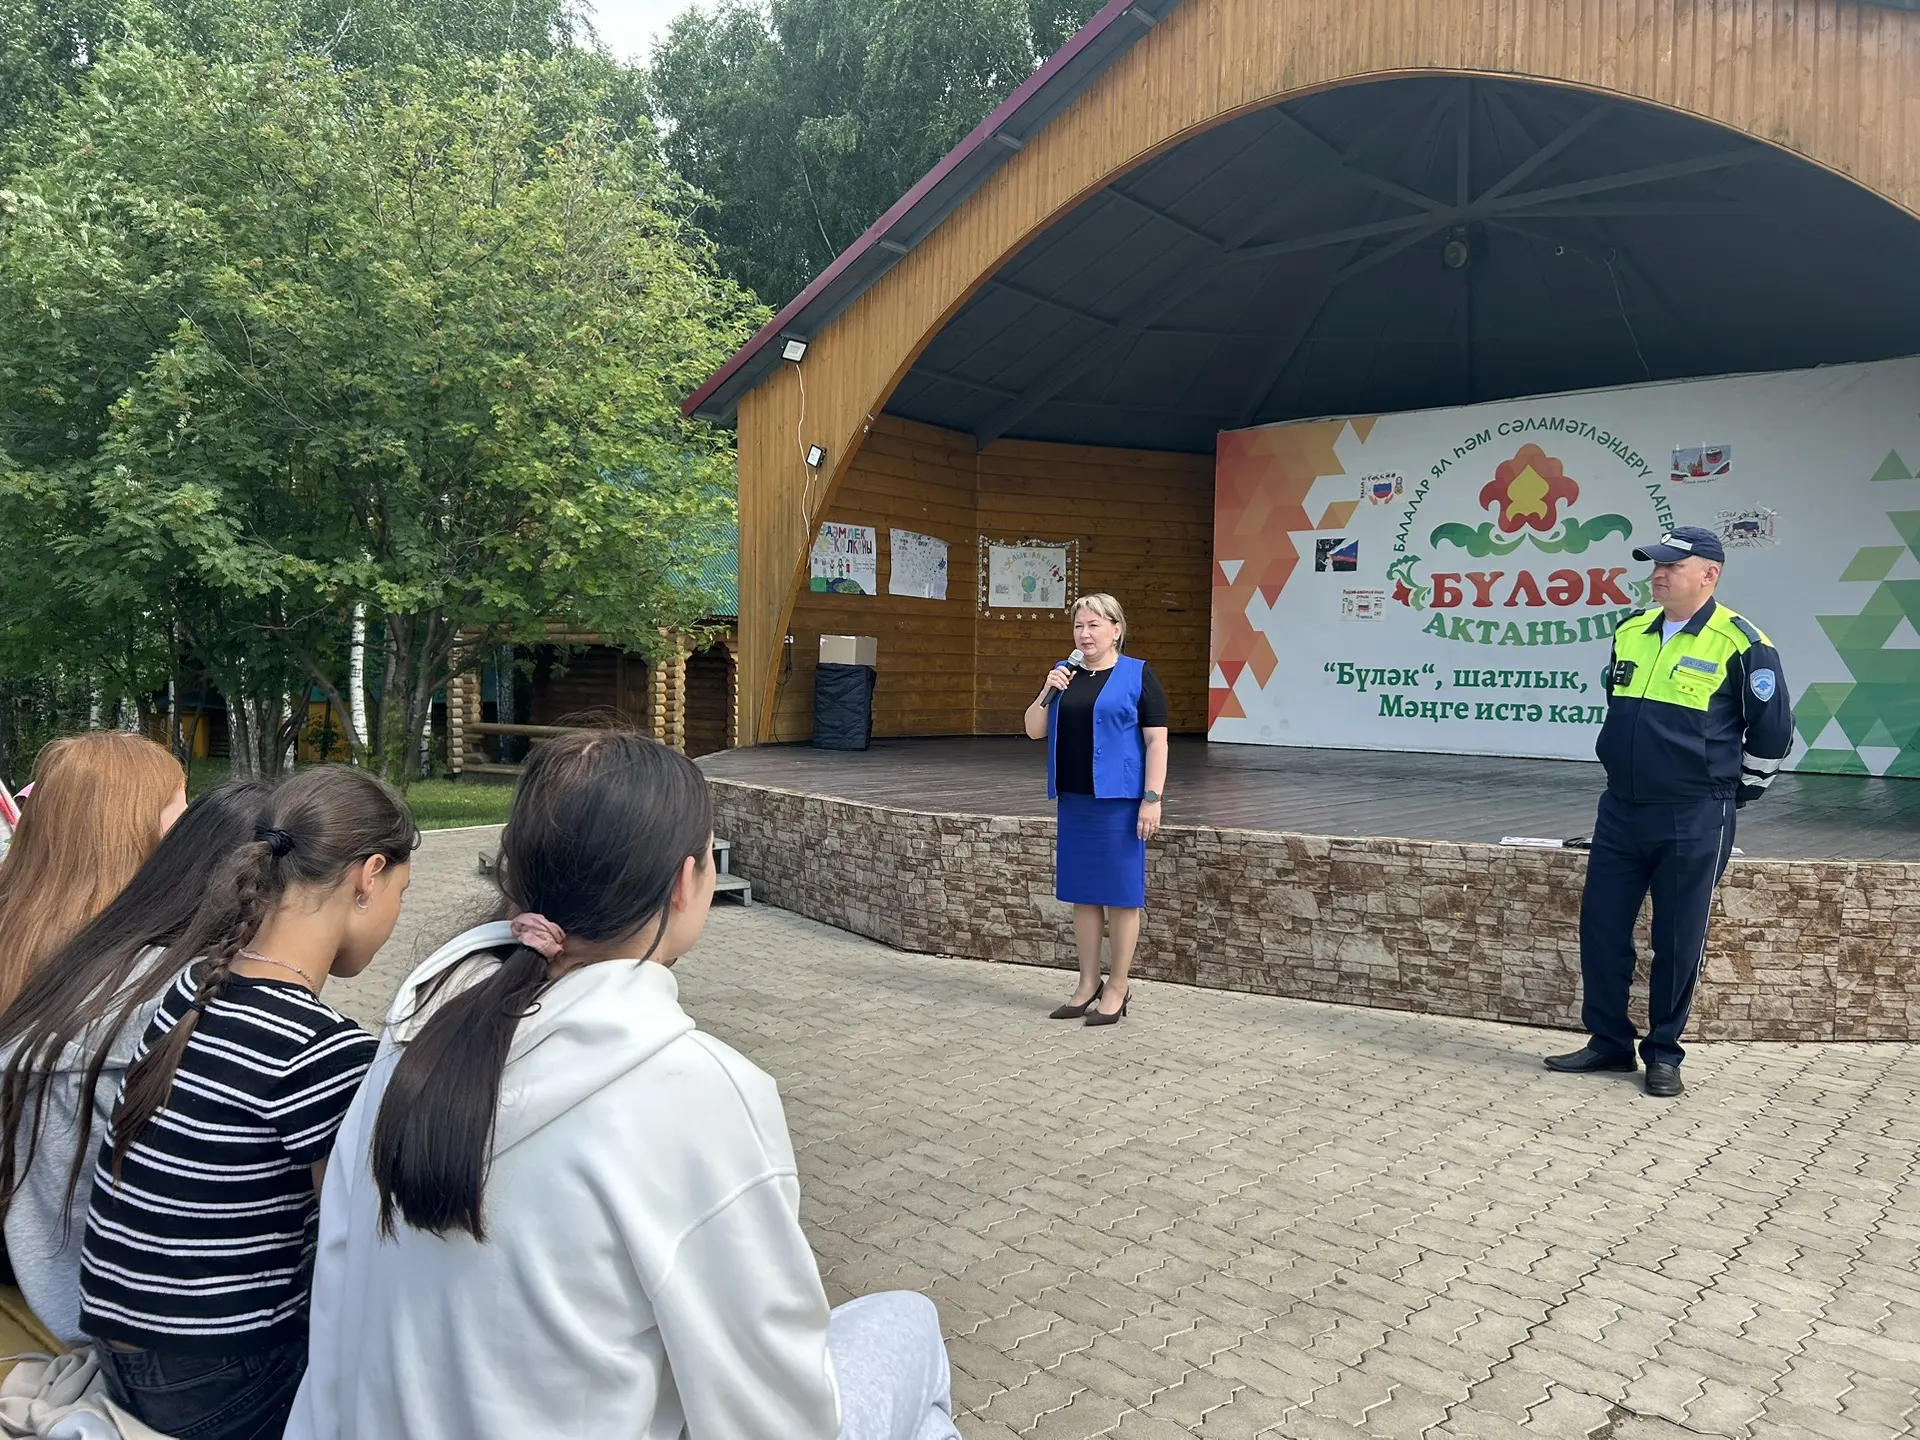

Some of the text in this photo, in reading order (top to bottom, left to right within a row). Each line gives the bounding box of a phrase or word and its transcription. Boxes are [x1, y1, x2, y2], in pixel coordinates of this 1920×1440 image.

[1393, 479, 1430, 552] БАЛАЛАР
[1431, 458, 1453, 478] ЯЛ
[1645, 484, 1675, 537] ЛАГЕР
[1429, 567, 1632, 608] БҮЛӘК
[1422, 607, 1632, 647] АКТАНЫШ
[1453, 669, 1588, 693] шатлык,
[1378, 694, 1469, 723] Мәңге
[1474, 702, 1543, 722] истә
